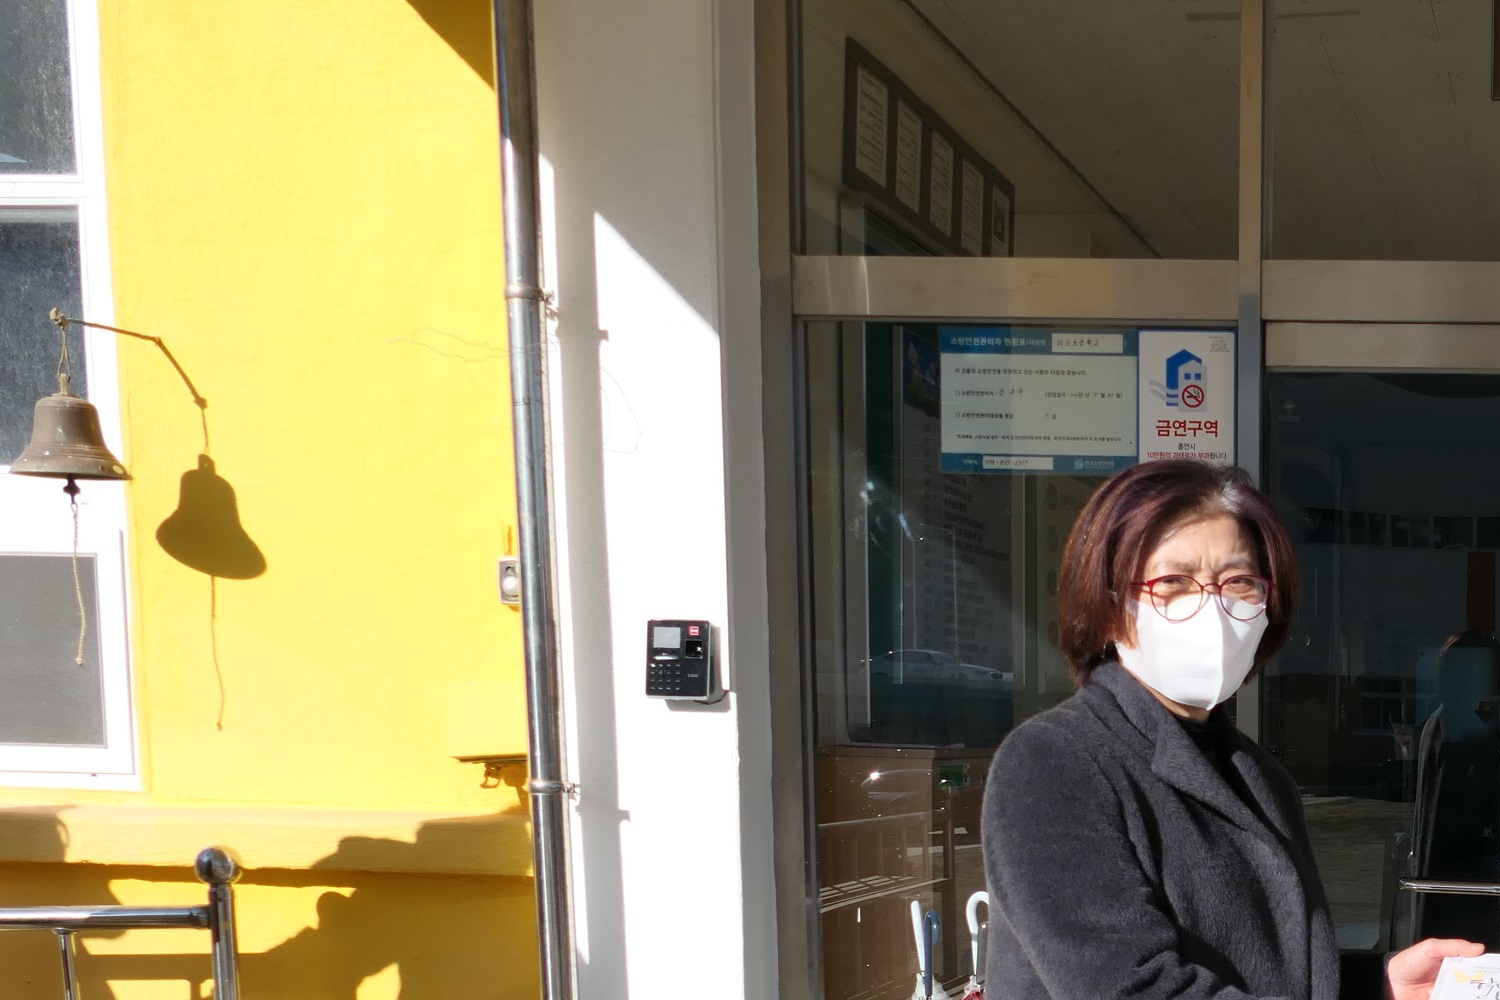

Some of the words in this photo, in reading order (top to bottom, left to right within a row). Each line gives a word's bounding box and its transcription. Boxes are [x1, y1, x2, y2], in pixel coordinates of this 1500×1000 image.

[951, 337, 1002, 346] 소방안전관리자
[1155, 419, 1218, 438] 금연구역
[1177, 442, 1196, 451] 흡연시
